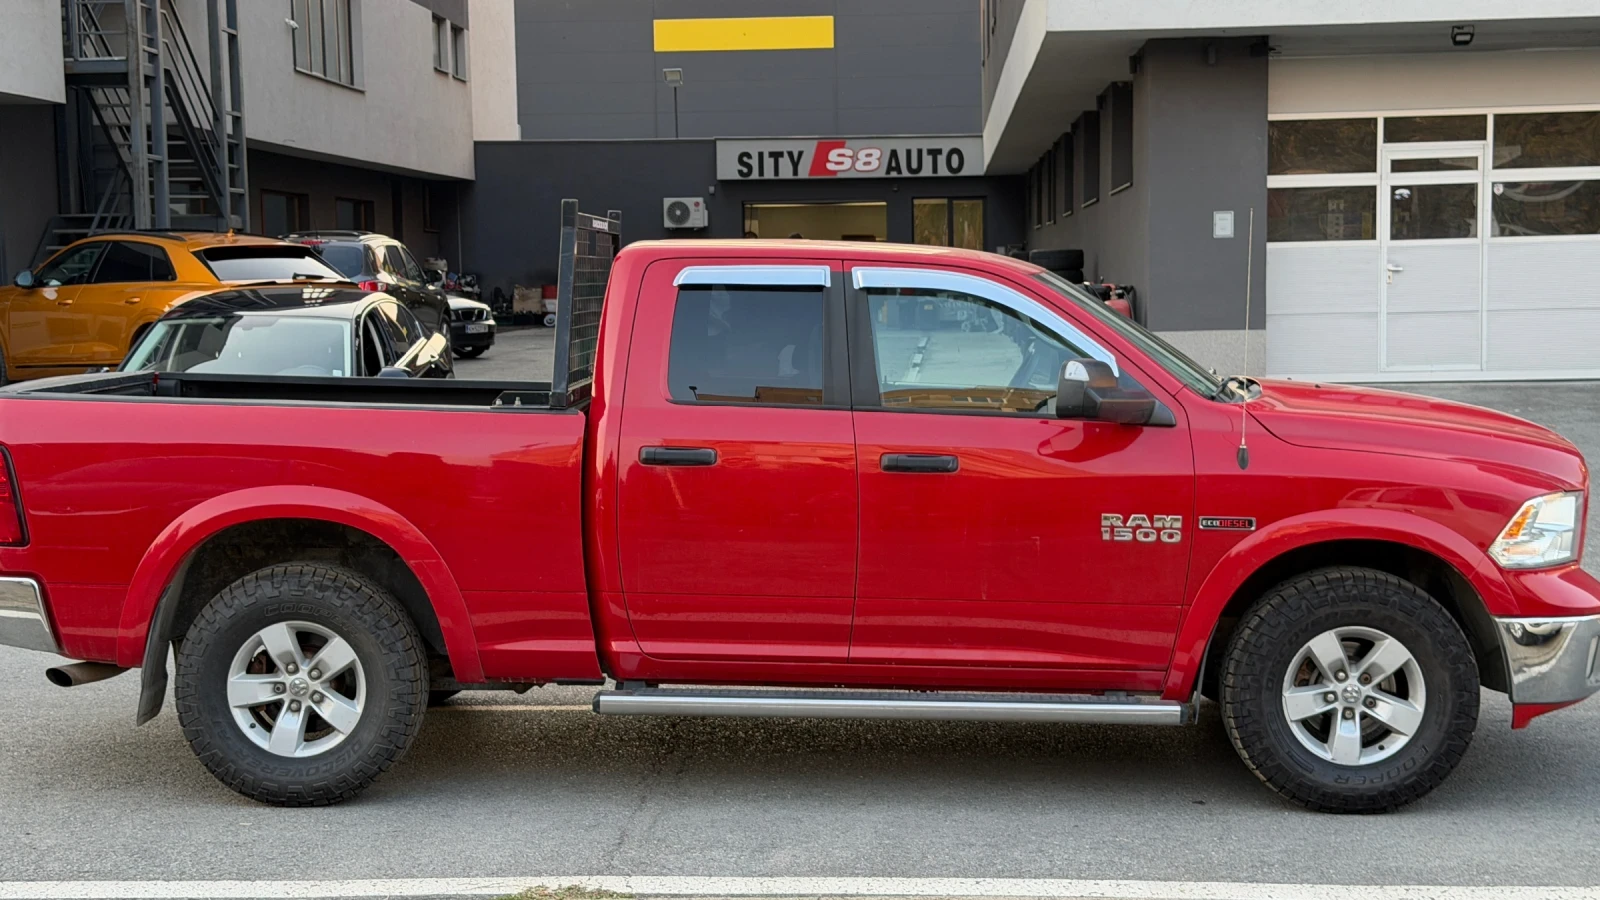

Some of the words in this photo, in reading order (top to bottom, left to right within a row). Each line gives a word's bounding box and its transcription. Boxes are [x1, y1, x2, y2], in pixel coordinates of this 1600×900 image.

[737, 150, 804, 178] SITY
[825, 147, 882, 172] S8
[885, 147, 965, 176] AUTO
[1101, 513, 1183, 528] RAM
[1101, 527, 1182, 543] 1500
[1202, 519, 1251, 528] ECODIESEL
[264, 602, 361, 640] COOPER
[235, 736, 365, 780] DISCOVERER
[1333, 744, 1430, 787] COOPER
